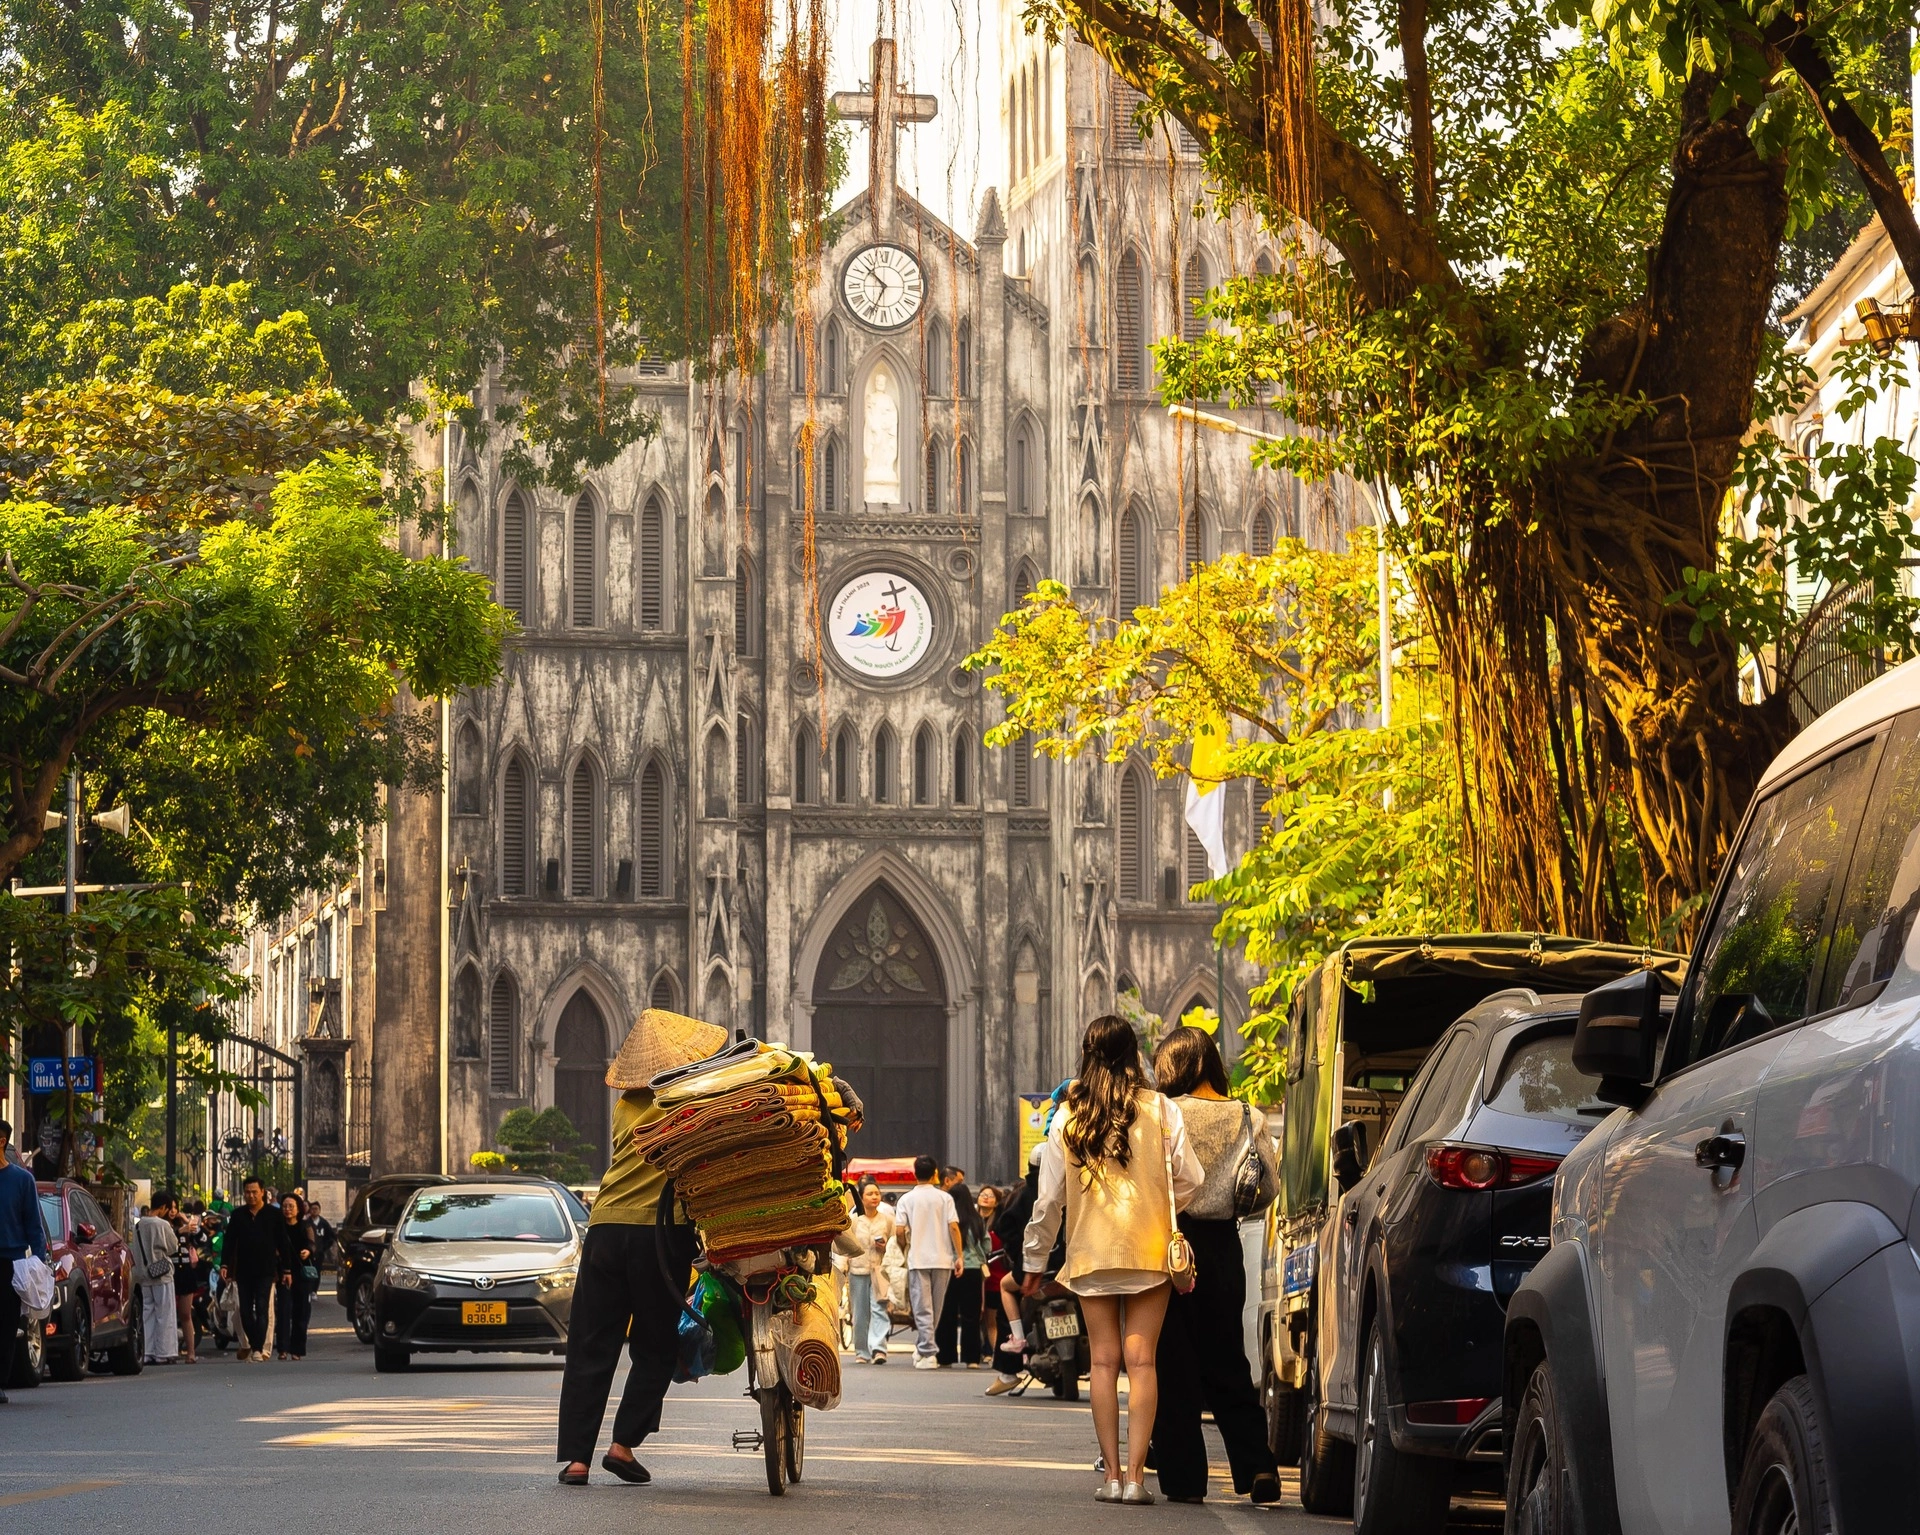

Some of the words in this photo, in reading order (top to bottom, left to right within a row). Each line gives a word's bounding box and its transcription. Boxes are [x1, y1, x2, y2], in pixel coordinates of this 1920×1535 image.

[56, 1061, 76, 1070] PỐ
[35, 1073, 55, 1088] NHÀ
[1500, 1235, 1550, 1247] CX-5
[475, 1303, 494, 1313] 30F
[467, 1313, 502, 1324] 838.65
[1050, 1315, 1073, 1327] 29-C1
